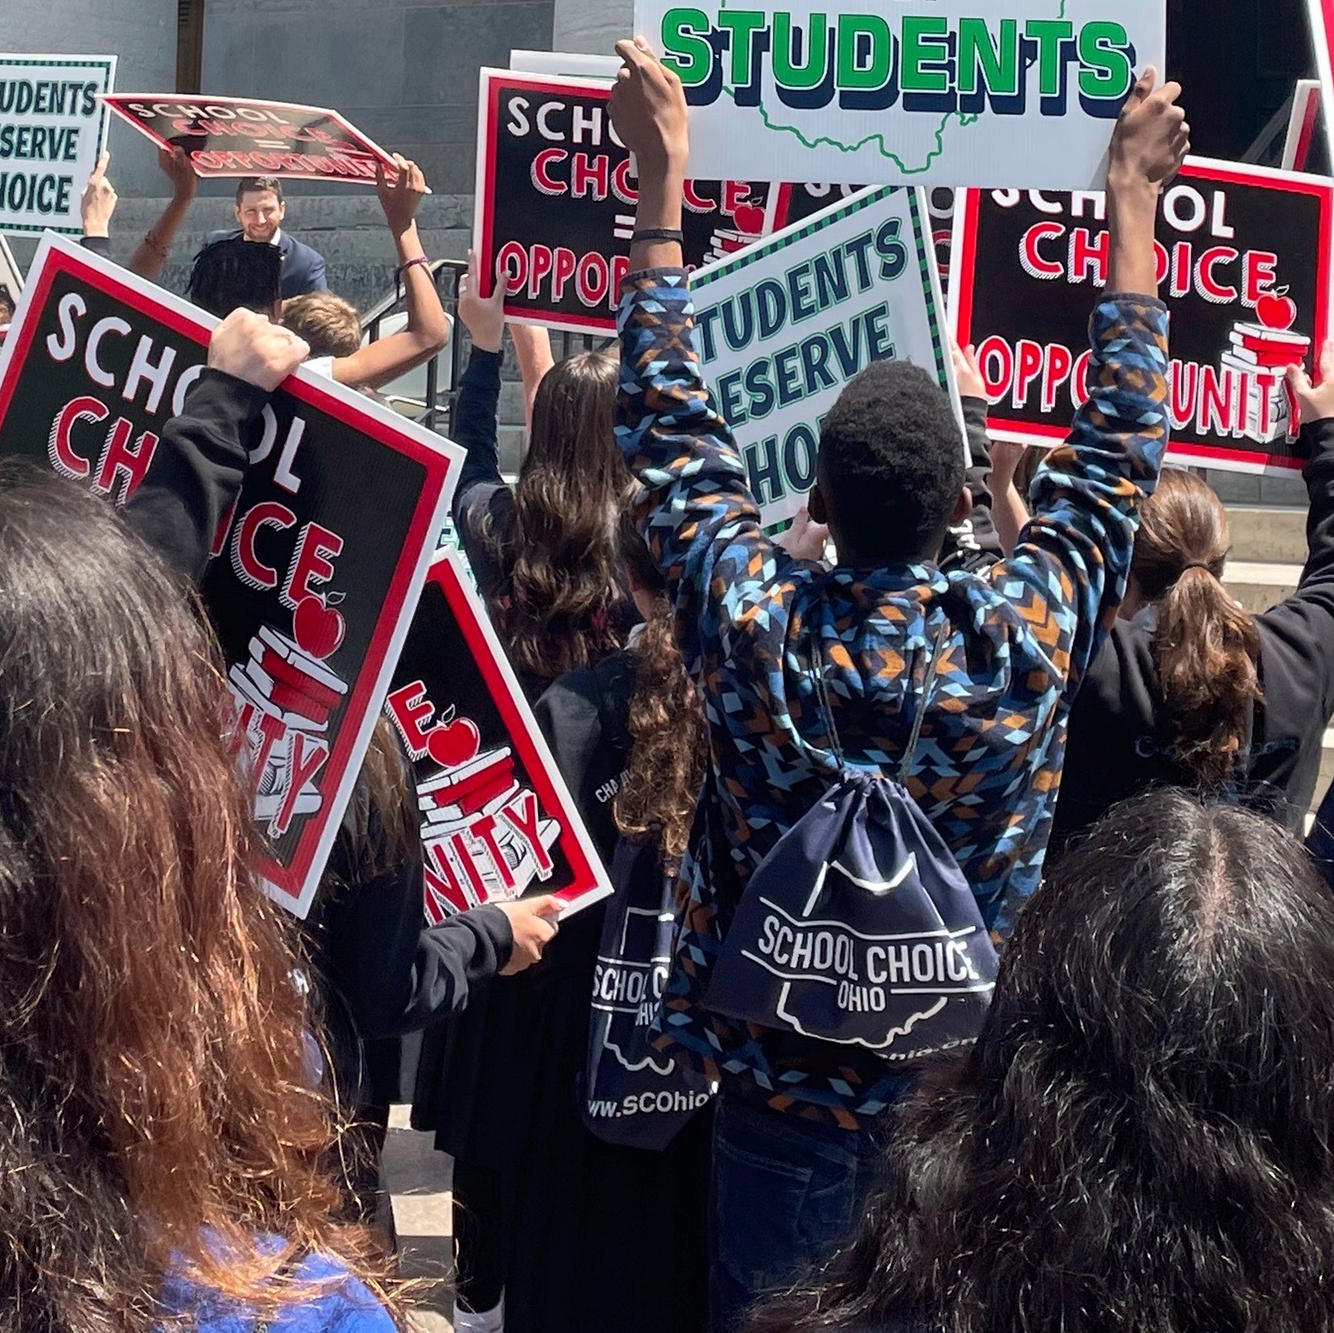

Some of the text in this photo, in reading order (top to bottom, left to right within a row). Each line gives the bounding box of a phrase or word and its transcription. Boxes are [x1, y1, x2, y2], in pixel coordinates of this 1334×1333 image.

[660, 7, 1137, 120] STUDENTS
[127, 102, 291, 125] SCHOOL
[171, 118, 335, 147] CHOICE
[695, 216, 908, 365] TUDENTS
[47, 395, 344, 611] CHCE
[757, 915, 859, 981] SCHOOL
[837, 981, 886, 1012] OHIO
